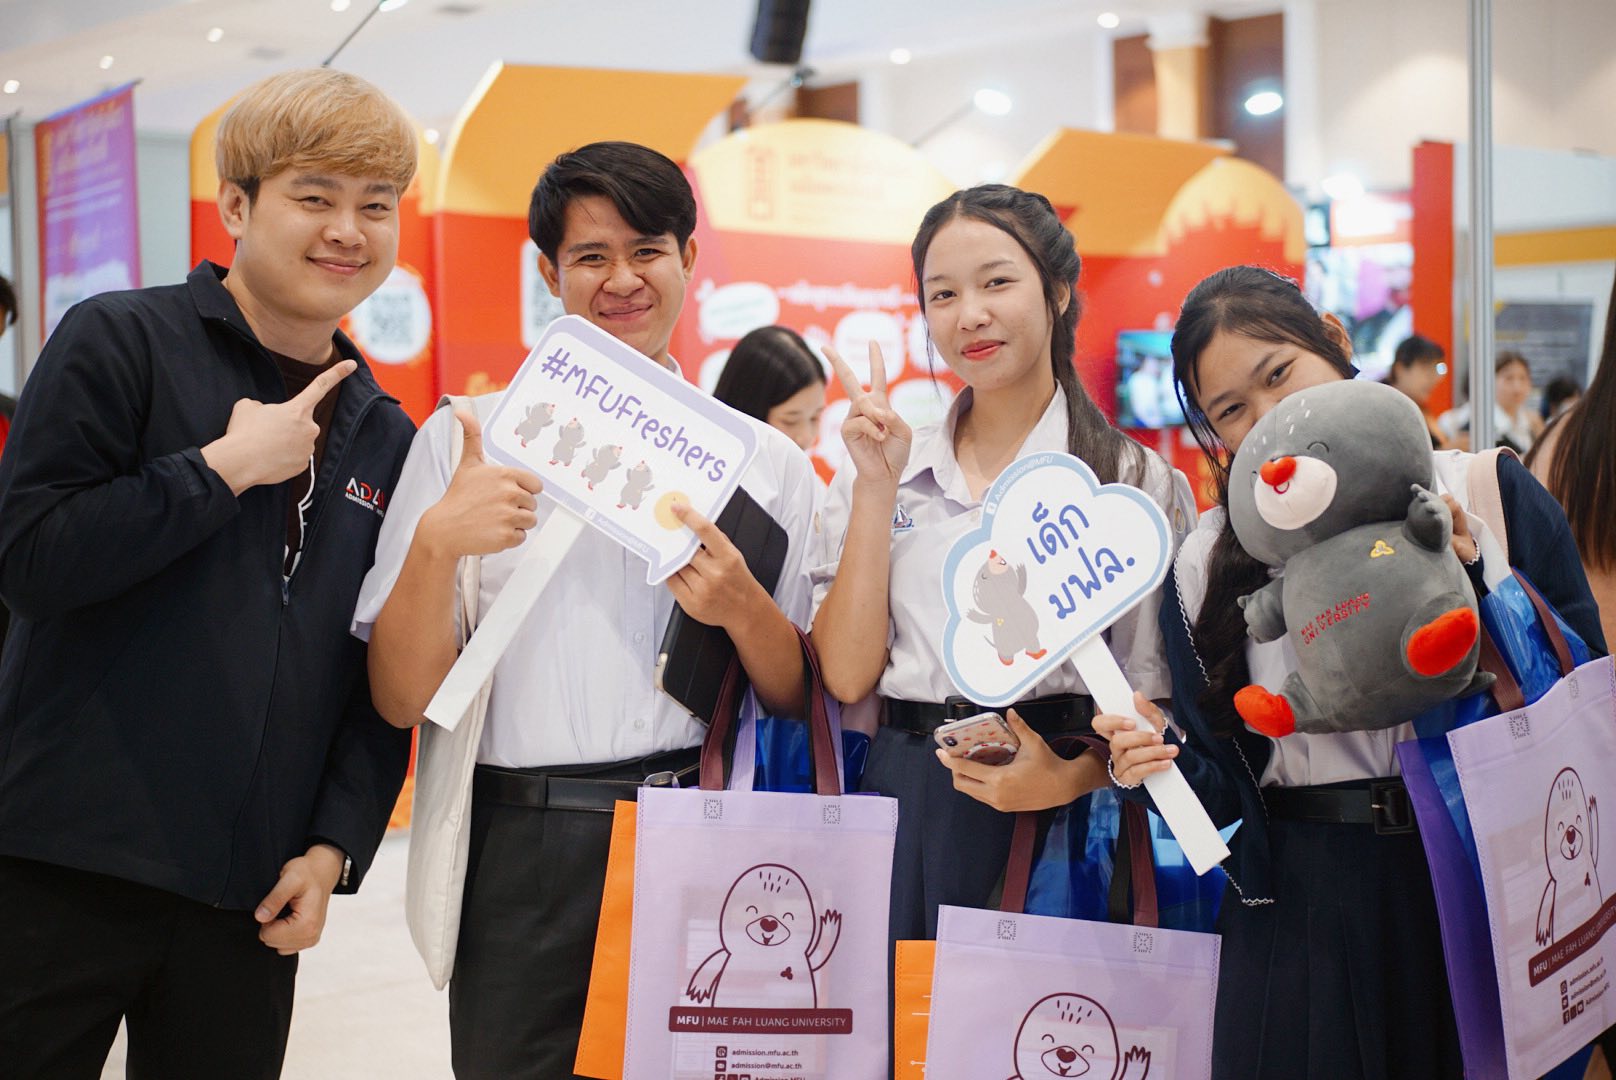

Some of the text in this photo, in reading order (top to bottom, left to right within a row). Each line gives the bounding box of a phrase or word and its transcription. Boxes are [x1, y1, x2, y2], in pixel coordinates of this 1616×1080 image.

[541, 347, 727, 483] #MFUFreshers
[1026, 501, 1090, 565] เด็ก
[1048, 546, 1136, 620] มฟล.
[1304, 602, 1369, 645] UNIVERSITY
[1533, 960, 1548, 977] MFU
[676, 1015, 846, 1027] MFU MAE FAH LUANG UNIVERSITY
